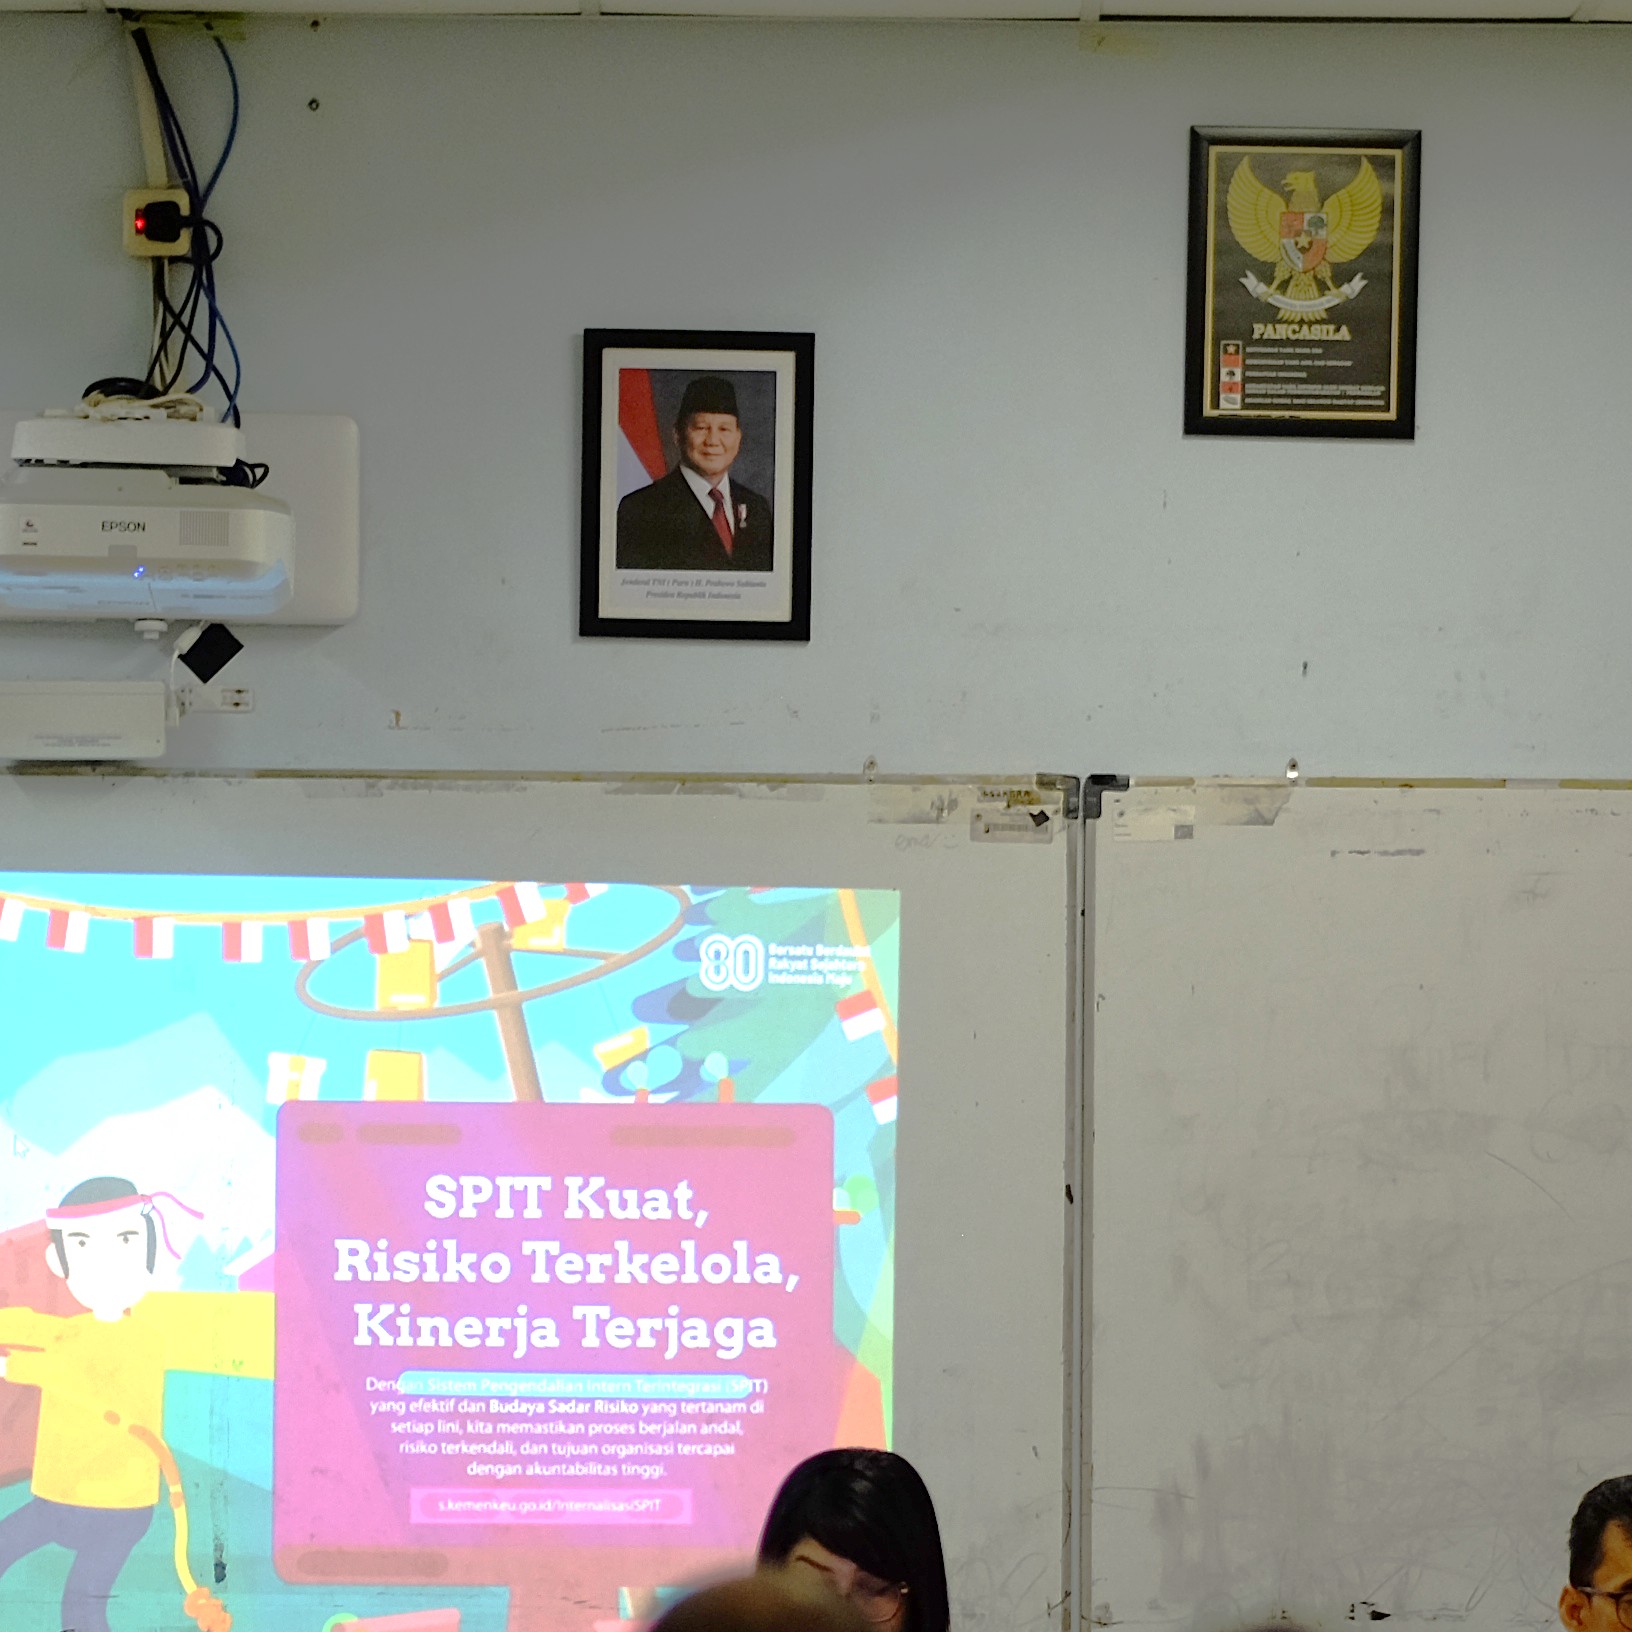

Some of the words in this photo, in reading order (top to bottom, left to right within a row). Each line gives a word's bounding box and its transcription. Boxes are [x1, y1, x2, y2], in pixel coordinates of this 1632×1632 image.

[1252, 323, 1352, 341] PANCASILA
[101, 520, 146, 532] EPSON
[699, 934, 765, 992] 80
[424, 1174, 552, 1219] SPIT
[564, 1175, 709, 1228] Kuat,
[333, 1238, 511, 1284] Risiko
[521, 1239, 800, 1292] Terkelola,
[352, 1303, 560, 1359] Kinerja
[572, 1304, 778, 1360] Terjaga
[366, 1376, 423, 1394] Dengan
[427, 1378, 476, 1391] Sistem
[480, 1378, 584, 1396] Pengendalian
[587, 1379, 631, 1392] Intern
[635, 1379, 721, 1396] Terintegrasi
[725, 1379, 768, 1394] (SPIT)
[369, 1401, 405, 1416] yang
[409, 1399, 455, 1413] efektif
[458, 1399, 486, 1413] dan
[489, 1399, 544, 1416] Budaya
[548, 1399, 590, 1413] Sadar
[594, 1400, 638, 1413] Risiko
[641, 1402, 677, 1417] yang
[680, 1401, 747, 1413] tertanam
[750, 1400, 764, 1413] di
[391, 1420, 434, 1436] setiap
[437, 1419, 463, 1435] lini,
[466, 1420, 493, 1434] kita
[496, 1420, 585, 1434] memastikan
[588, 1422, 635, 1436] proses
[639, 1420, 697, 1437] berjalan
[399, 1440, 438, 1454] risiko
[441, 1440, 517, 1456] terkendali,
[520, 1440, 548, 1455] dan
[551, 1441, 598, 1458] tujuan
[601, 1442, 674, 1459] organisasi
[677, 1443, 735, 1458] tercapai
[467, 1461, 521, 1479] dengan
[525, 1461, 618, 1476] akuntabilitas
[621, 1462, 667, 1479] tinggi.
